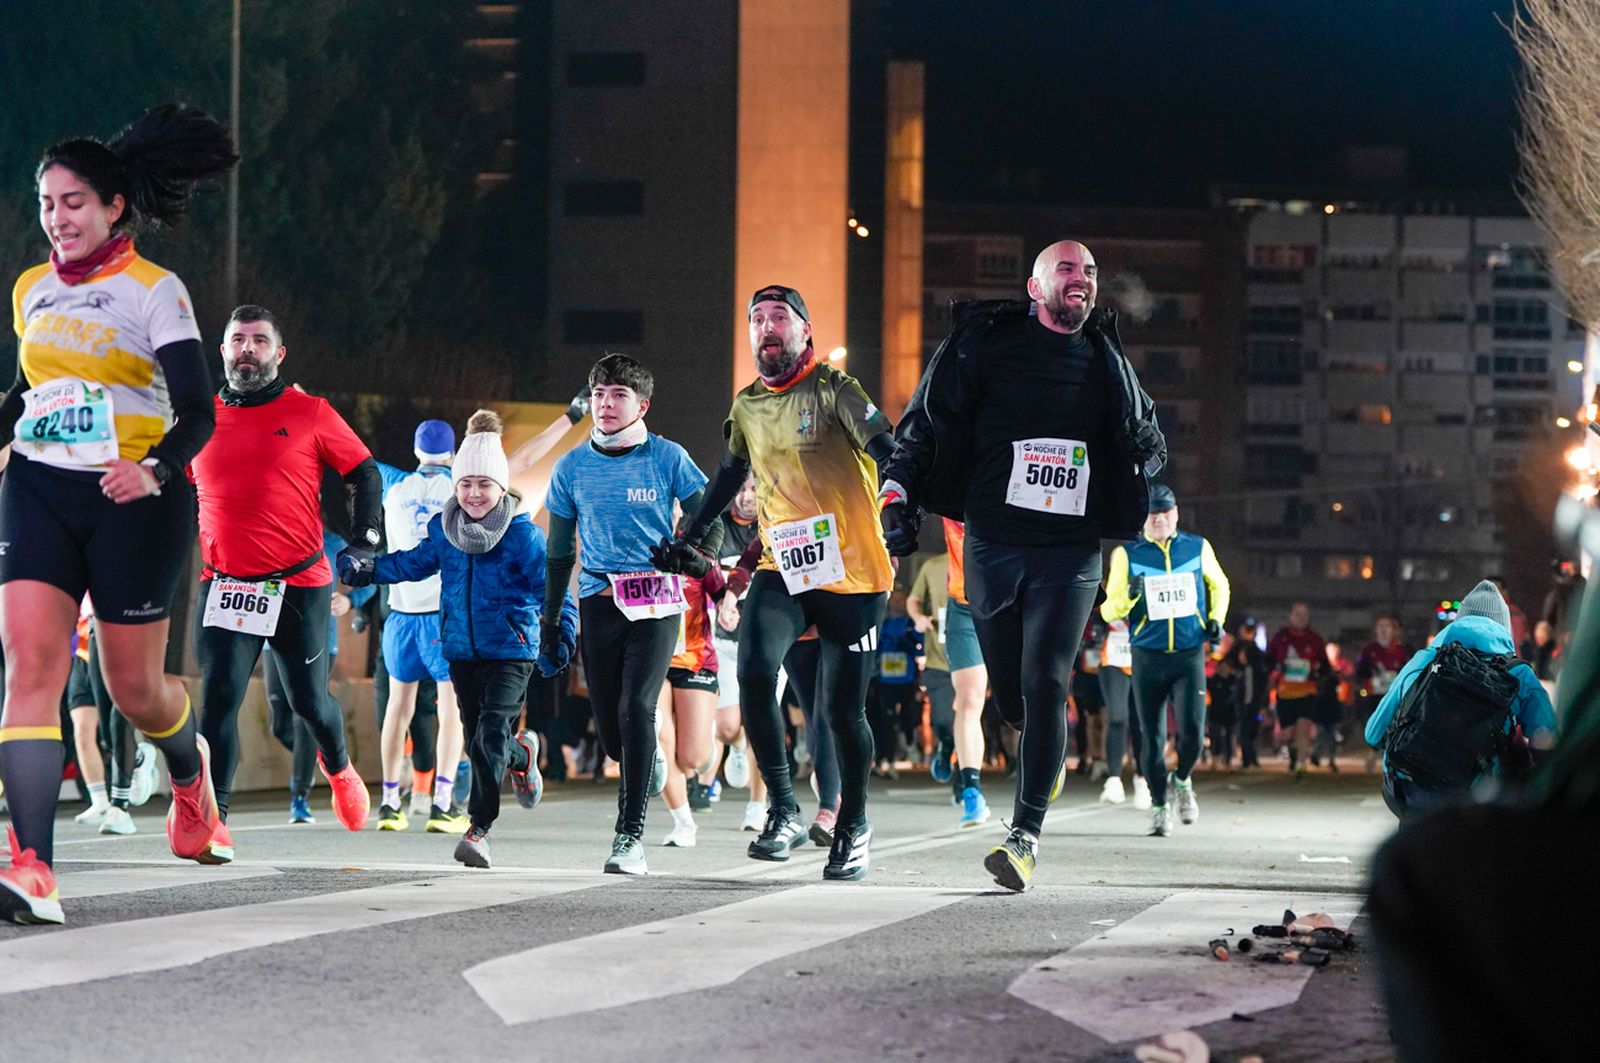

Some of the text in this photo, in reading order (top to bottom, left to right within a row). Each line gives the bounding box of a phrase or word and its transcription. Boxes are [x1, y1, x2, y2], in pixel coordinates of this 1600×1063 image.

[33, 406, 93, 438] 8240
[1023, 453, 1040, 462] SAN
[1040, 454, 1067, 465] ANTÓN
[1033, 446, 1067, 455] NOCHE DE
[1026, 463, 1078, 489] 5068
[626, 488, 657, 502] M10
[799, 527, 808, 535] DE
[781, 541, 825, 571] 5067
[219, 592, 269, 614] 5066
